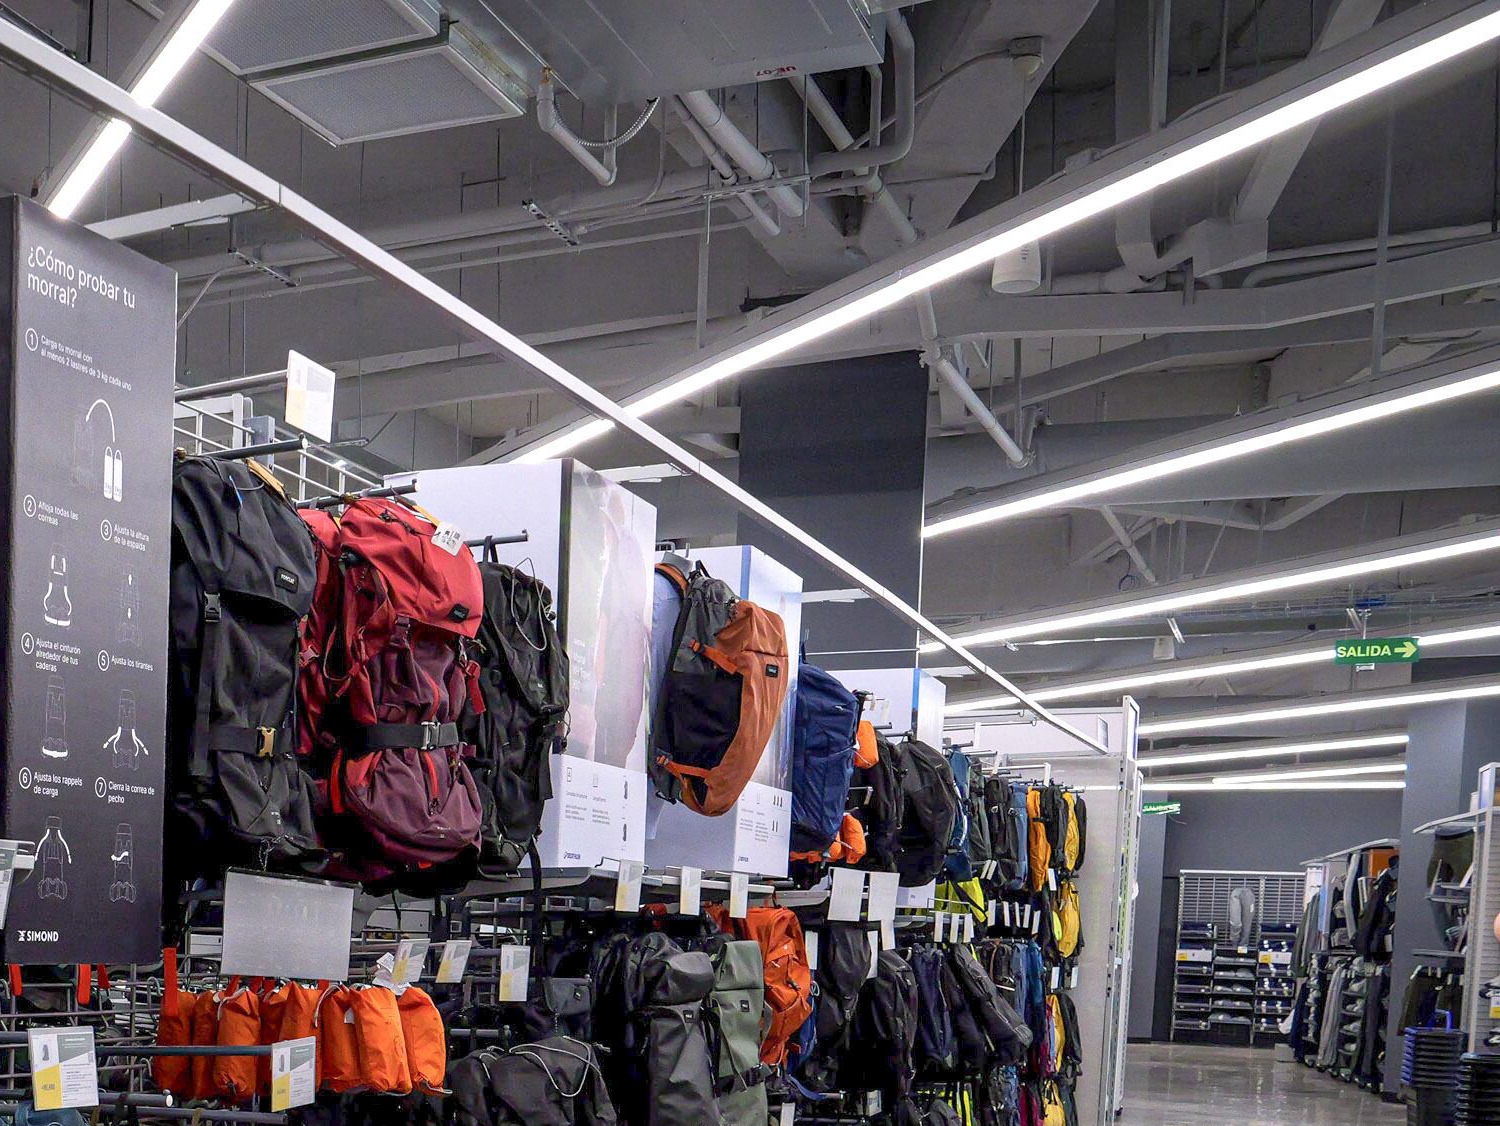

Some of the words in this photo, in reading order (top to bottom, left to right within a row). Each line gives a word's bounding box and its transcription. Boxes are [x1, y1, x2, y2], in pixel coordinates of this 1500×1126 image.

[27, 246, 75, 281] ¿Cómo
[78, 269, 120, 301] probar
[123, 287, 135, 309] tu
[27, 272, 78, 309] morral?
[41, 335, 57, 350] Carga
[65, 345, 82, 359] morral
[83, 352, 93, 363] con
[47, 350, 65, 365] menos
[89, 366, 96, 377] de
[101, 371, 108, 384] kg
[108, 374, 121, 388] cada
[121, 380, 132, 391] uno
[54, 506, 69, 518] todas
[38, 513, 59, 526] correas
[114, 524, 129, 536] Ajusta
[36, 638, 53, 650] Ajusta
[36, 650, 61, 662] alrededor
[62, 654, 69, 663] de
[70, 656, 79, 666] tus
[1336, 645, 1392, 658] SALIDA
[36, 661, 57, 673] caderas
[111, 655, 126, 666] Ajusta
[34, 772, 52, 783] Ajusta
[52, 774, 61, 783] los
[34, 785, 42, 794] de
[42, 787, 59, 798] carga
[108, 781, 125, 792] Cierra
[131, 785, 147, 795] correa
[148, 786, 155, 795] de
[108, 795, 125, 804] pecho
[26, 930, 59, 942] SIMOND
